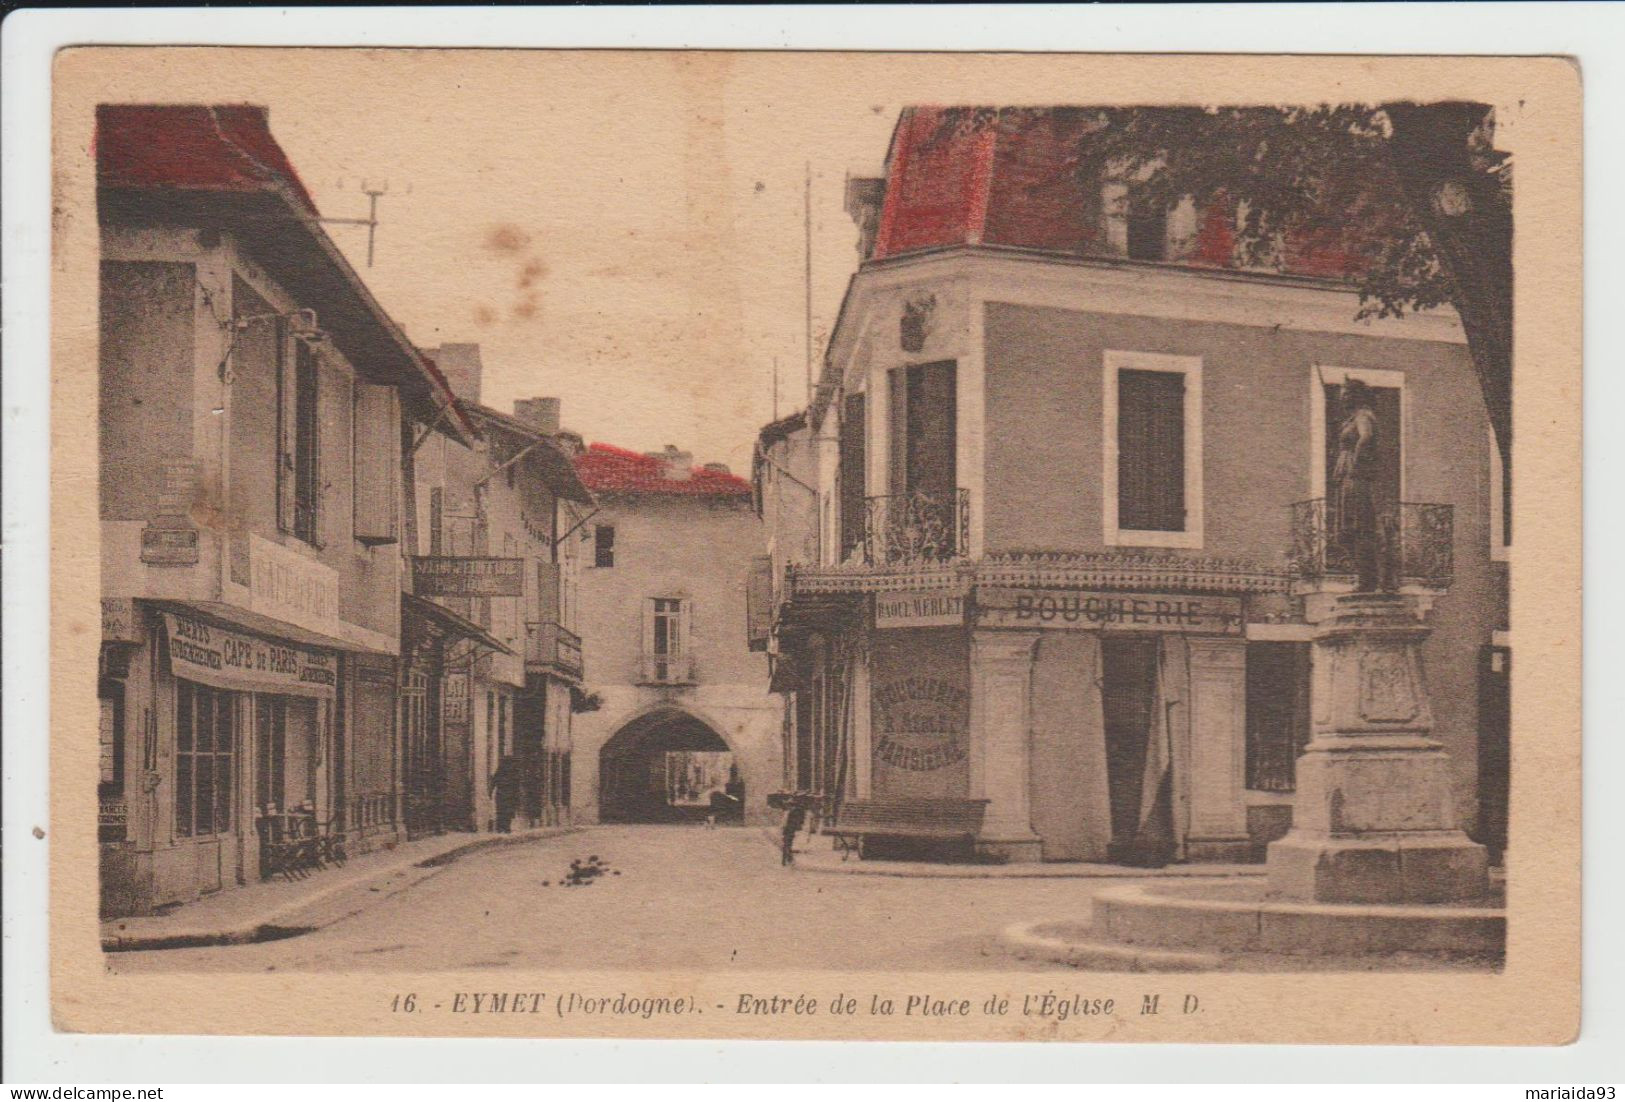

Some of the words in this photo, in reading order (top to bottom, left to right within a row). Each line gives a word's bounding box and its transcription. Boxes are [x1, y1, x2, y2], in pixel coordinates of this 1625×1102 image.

[1015, 595, 1202, 625] BOUCHERIE
[452, 993, 546, 1014] EYMET
[736, 993, 818, 1015] Entrée
[829, 994, 857, 1015] de
[870, 994, 895, 1016] la
[904, 994, 971, 1017] Place
[983, 994, 1010, 1015] de
[1022, 990, 1115, 1021] l'Église
